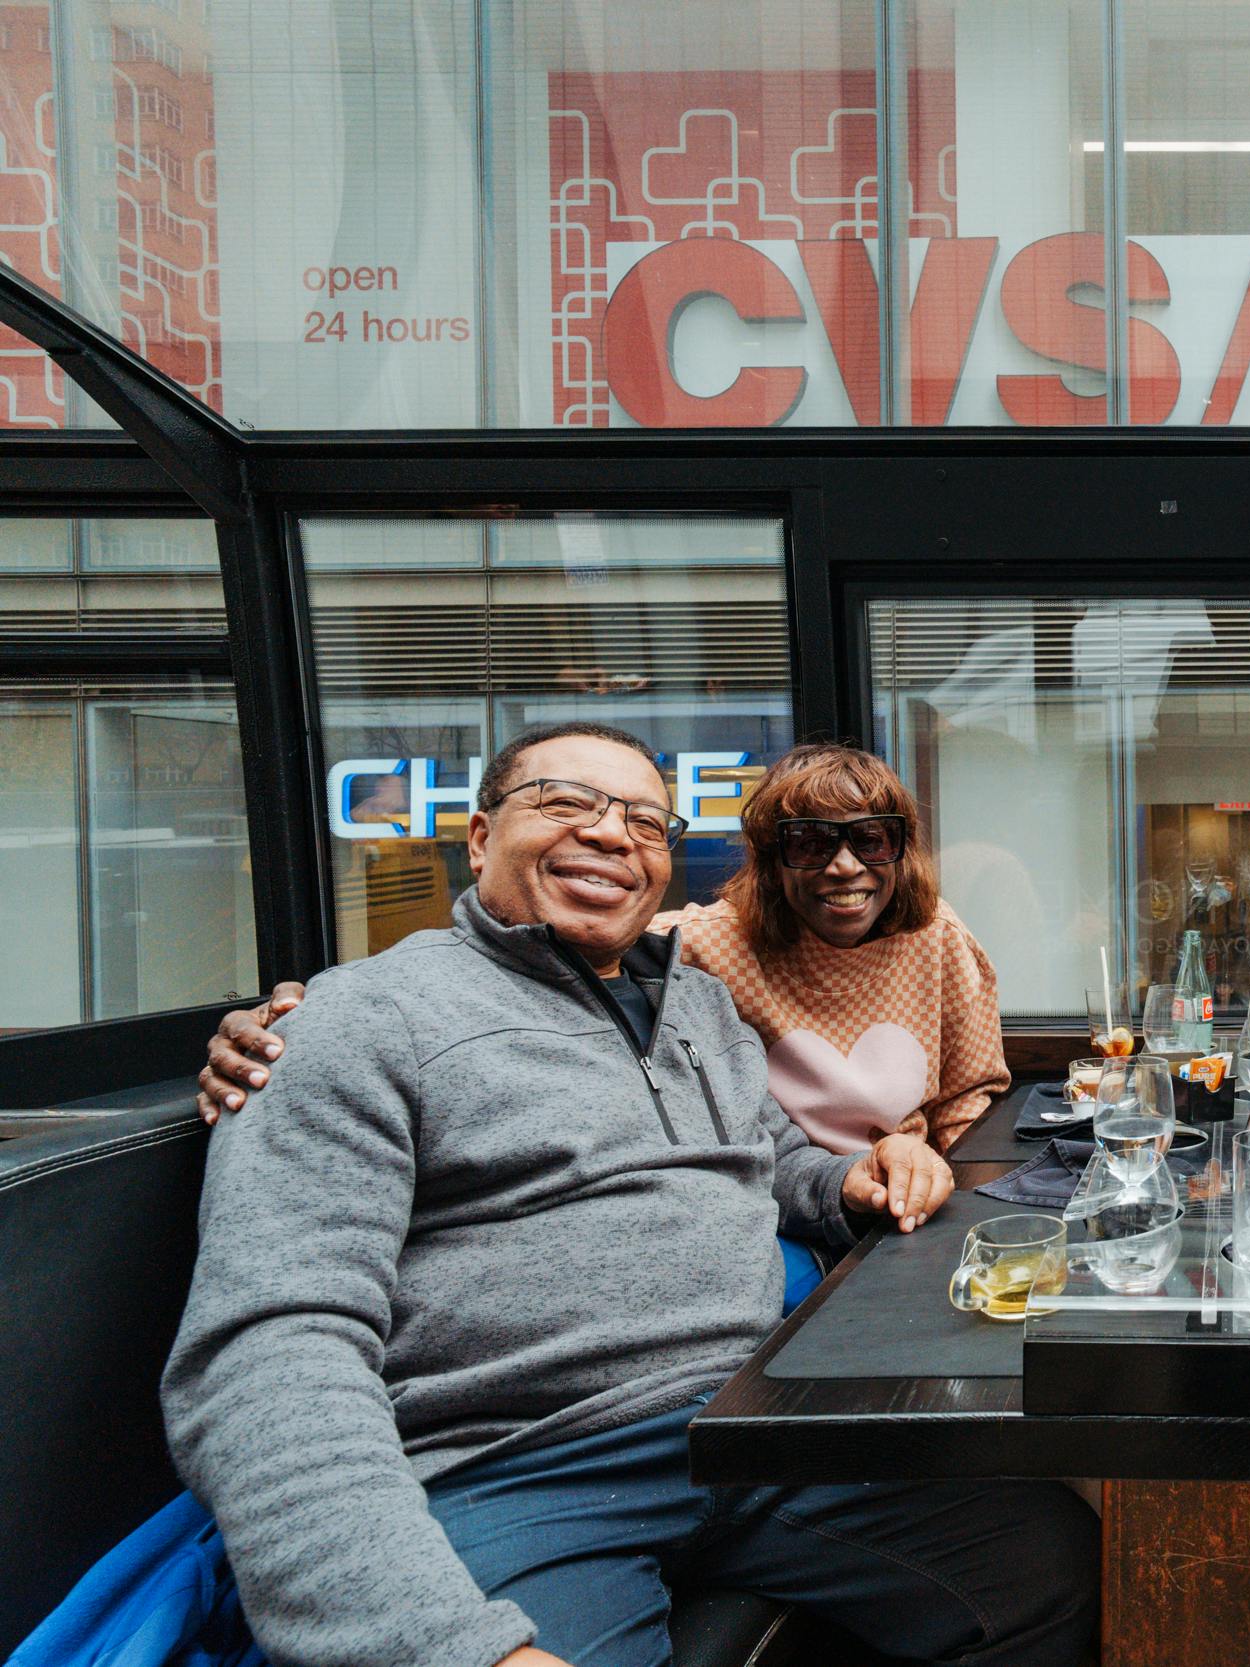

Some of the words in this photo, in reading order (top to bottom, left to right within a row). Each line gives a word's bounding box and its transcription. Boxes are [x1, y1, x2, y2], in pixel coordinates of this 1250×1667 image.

[302, 265, 399, 299] open
[303, 310, 349, 344] 24
[362, 310, 471, 343] hours
[326, 751, 747, 840] CHE
